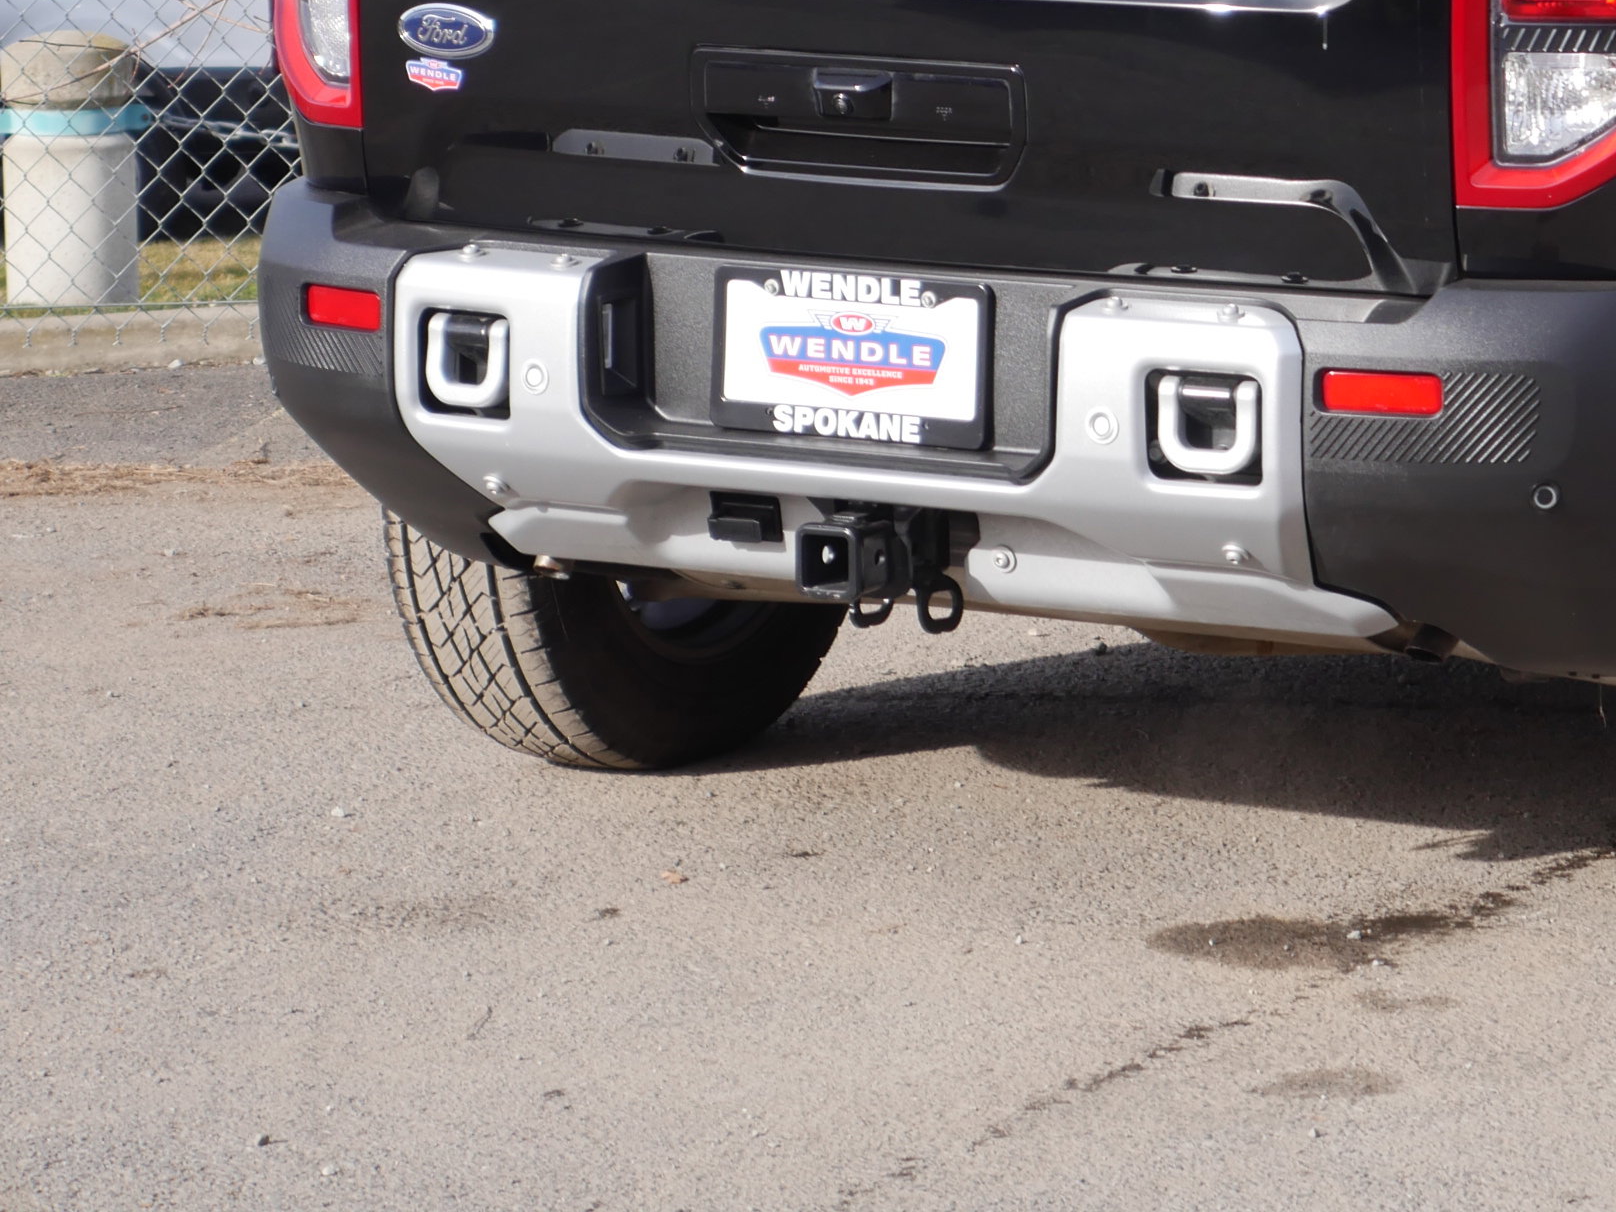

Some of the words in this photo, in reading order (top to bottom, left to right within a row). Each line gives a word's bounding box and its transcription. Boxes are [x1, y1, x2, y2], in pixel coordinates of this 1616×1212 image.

[417, 14, 468, 45] Ford
[410, 65, 457, 81] WENDLE
[780, 269, 922, 307] WENDLE
[769, 335, 932, 366] WENDLE
[798, 364, 851, 375] AUTOMOTIVE
[772, 404, 922, 444] SPOKANE
